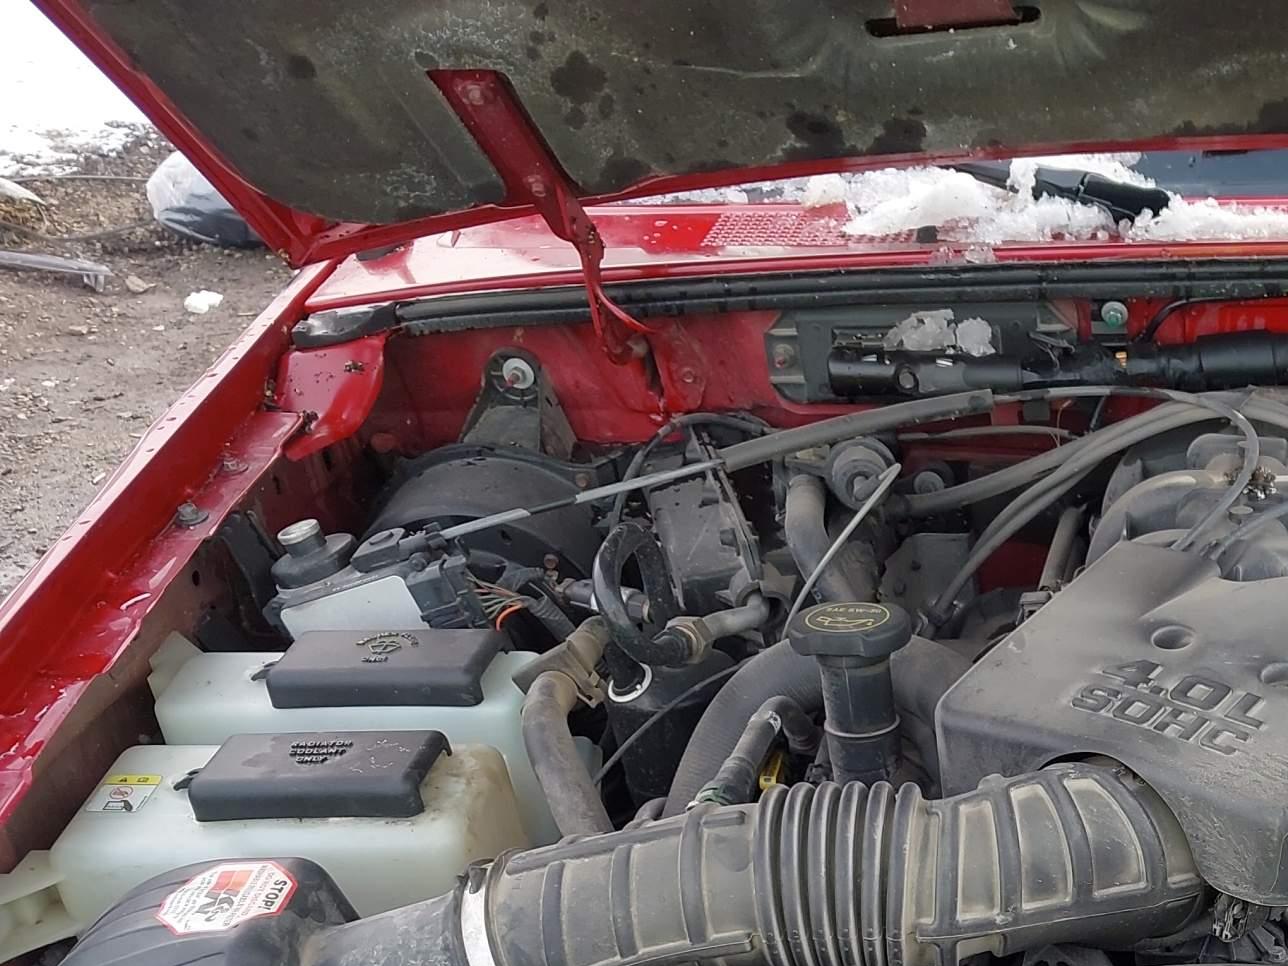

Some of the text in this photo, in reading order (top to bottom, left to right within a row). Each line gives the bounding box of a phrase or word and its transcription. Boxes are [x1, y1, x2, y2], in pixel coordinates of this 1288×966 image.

[1102, 659, 1264, 729] 4.0L
[1071, 685, 1251, 755] SOHC
[291, 740, 353, 749] RADIATOR
[296, 756, 328, 764] ONLY
[258, 880, 288, 910] STOP!
